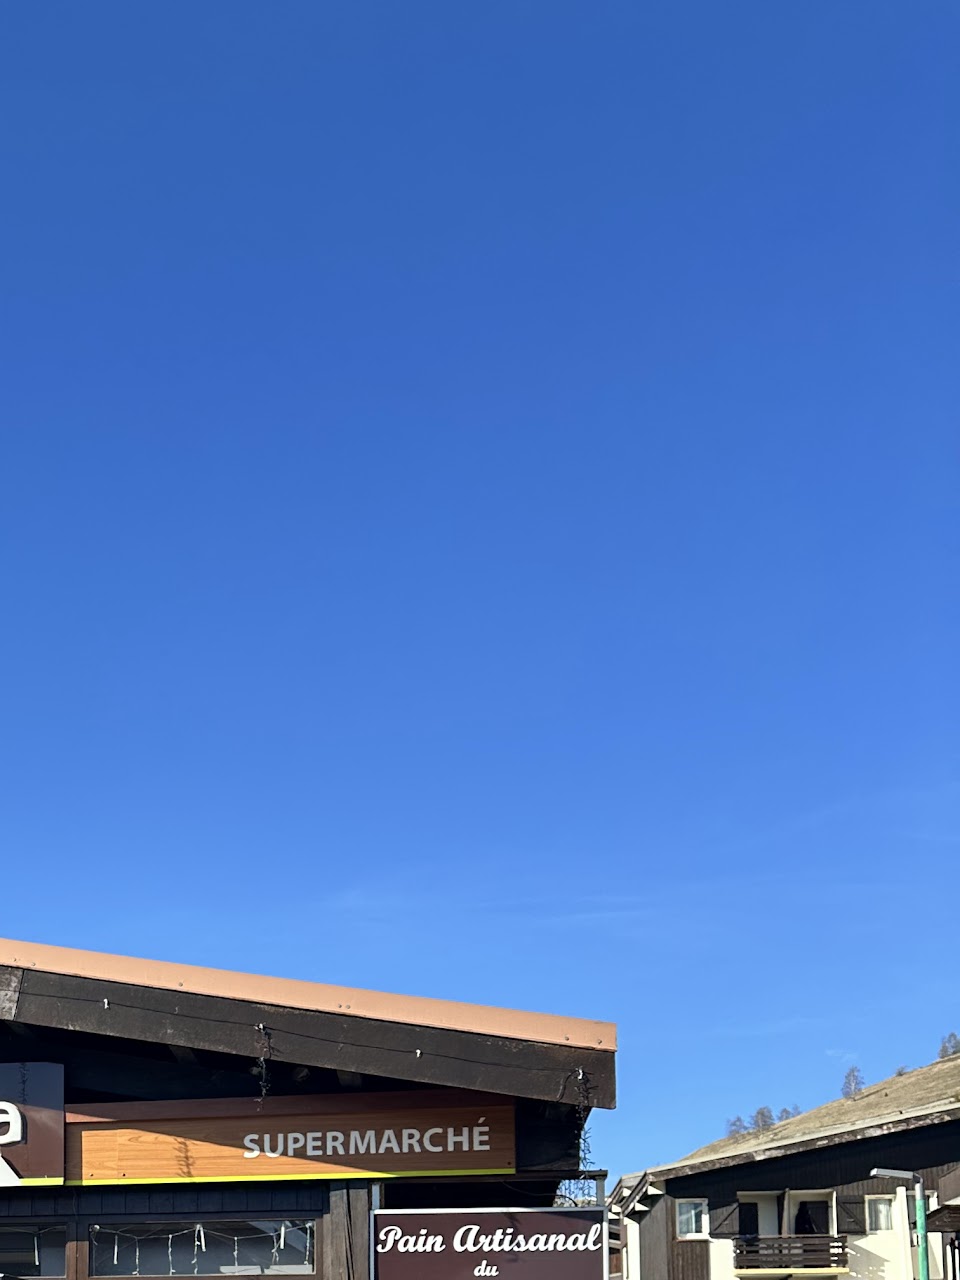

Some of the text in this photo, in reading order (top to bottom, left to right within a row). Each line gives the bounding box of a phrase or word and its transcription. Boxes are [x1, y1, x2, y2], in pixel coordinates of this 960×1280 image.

[243, 1117, 490, 1158] SUPERMARCHÉ
[376, 1223, 601, 1253] Pain Artisanal
[474, 1259, 498, 1277] du
